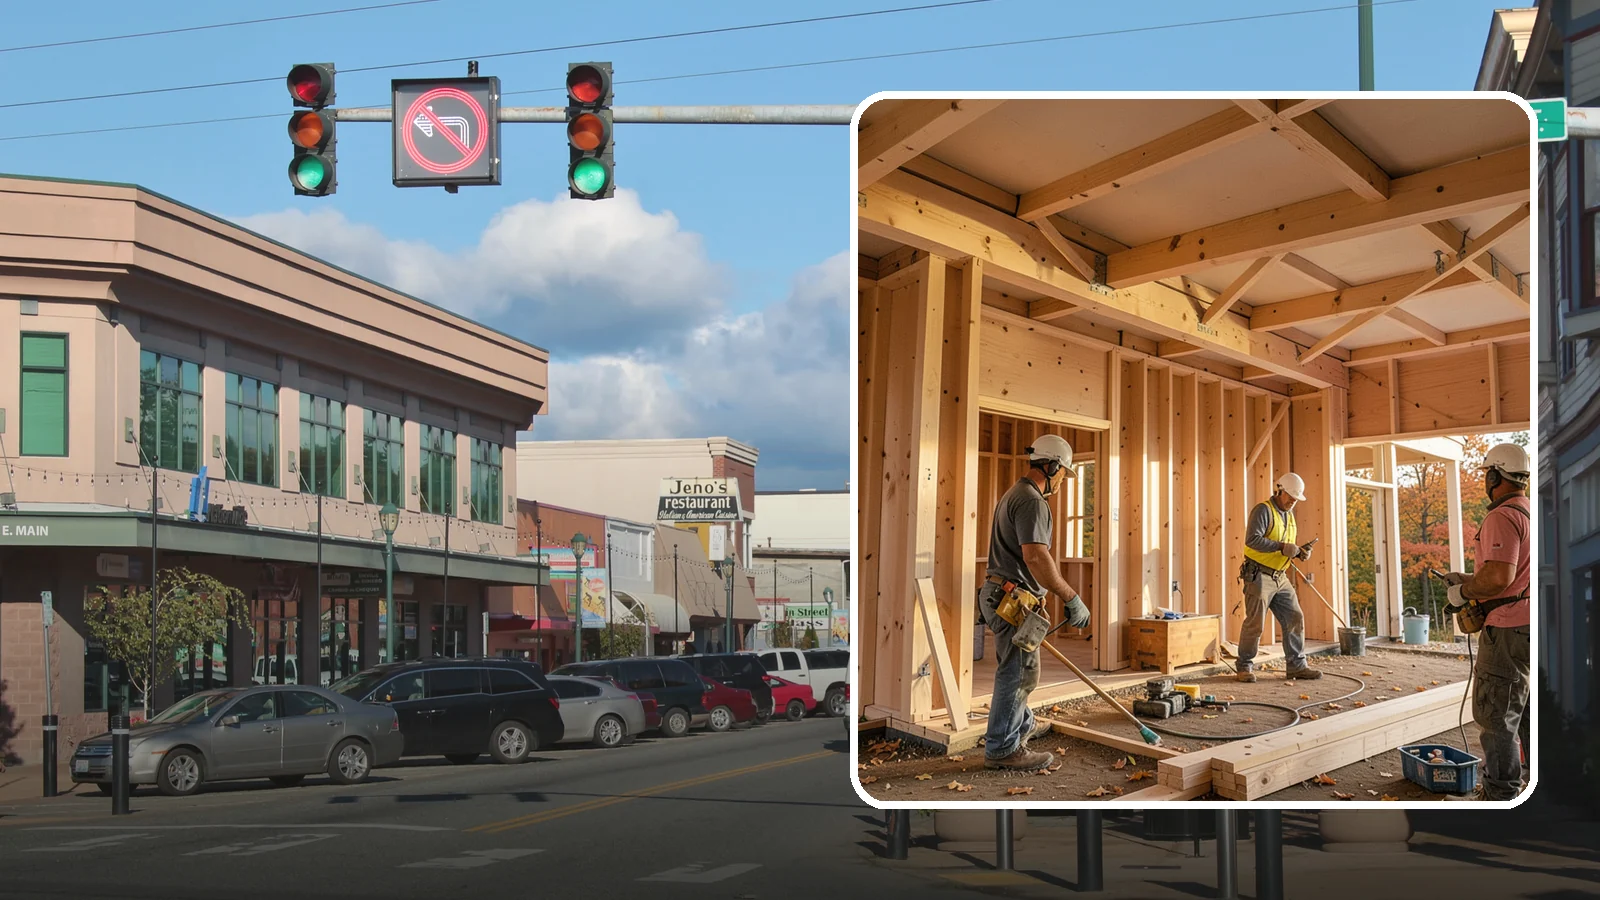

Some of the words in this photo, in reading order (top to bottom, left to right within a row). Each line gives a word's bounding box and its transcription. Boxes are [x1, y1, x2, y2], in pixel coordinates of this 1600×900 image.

[670, 480, 727, 494] Jeno's
[665, 496, 731, 509] restaurant
[658, 510, 682, 519] Italian
[686, 510, 714, 519] American
[715, 509, 737, 519] Cuisine
[2, 525, 13, 536] E.
[15, 525, 49, 536] MAIN
[797, 607, 828, 616] Street
[791, 619, 824, 627] lass
